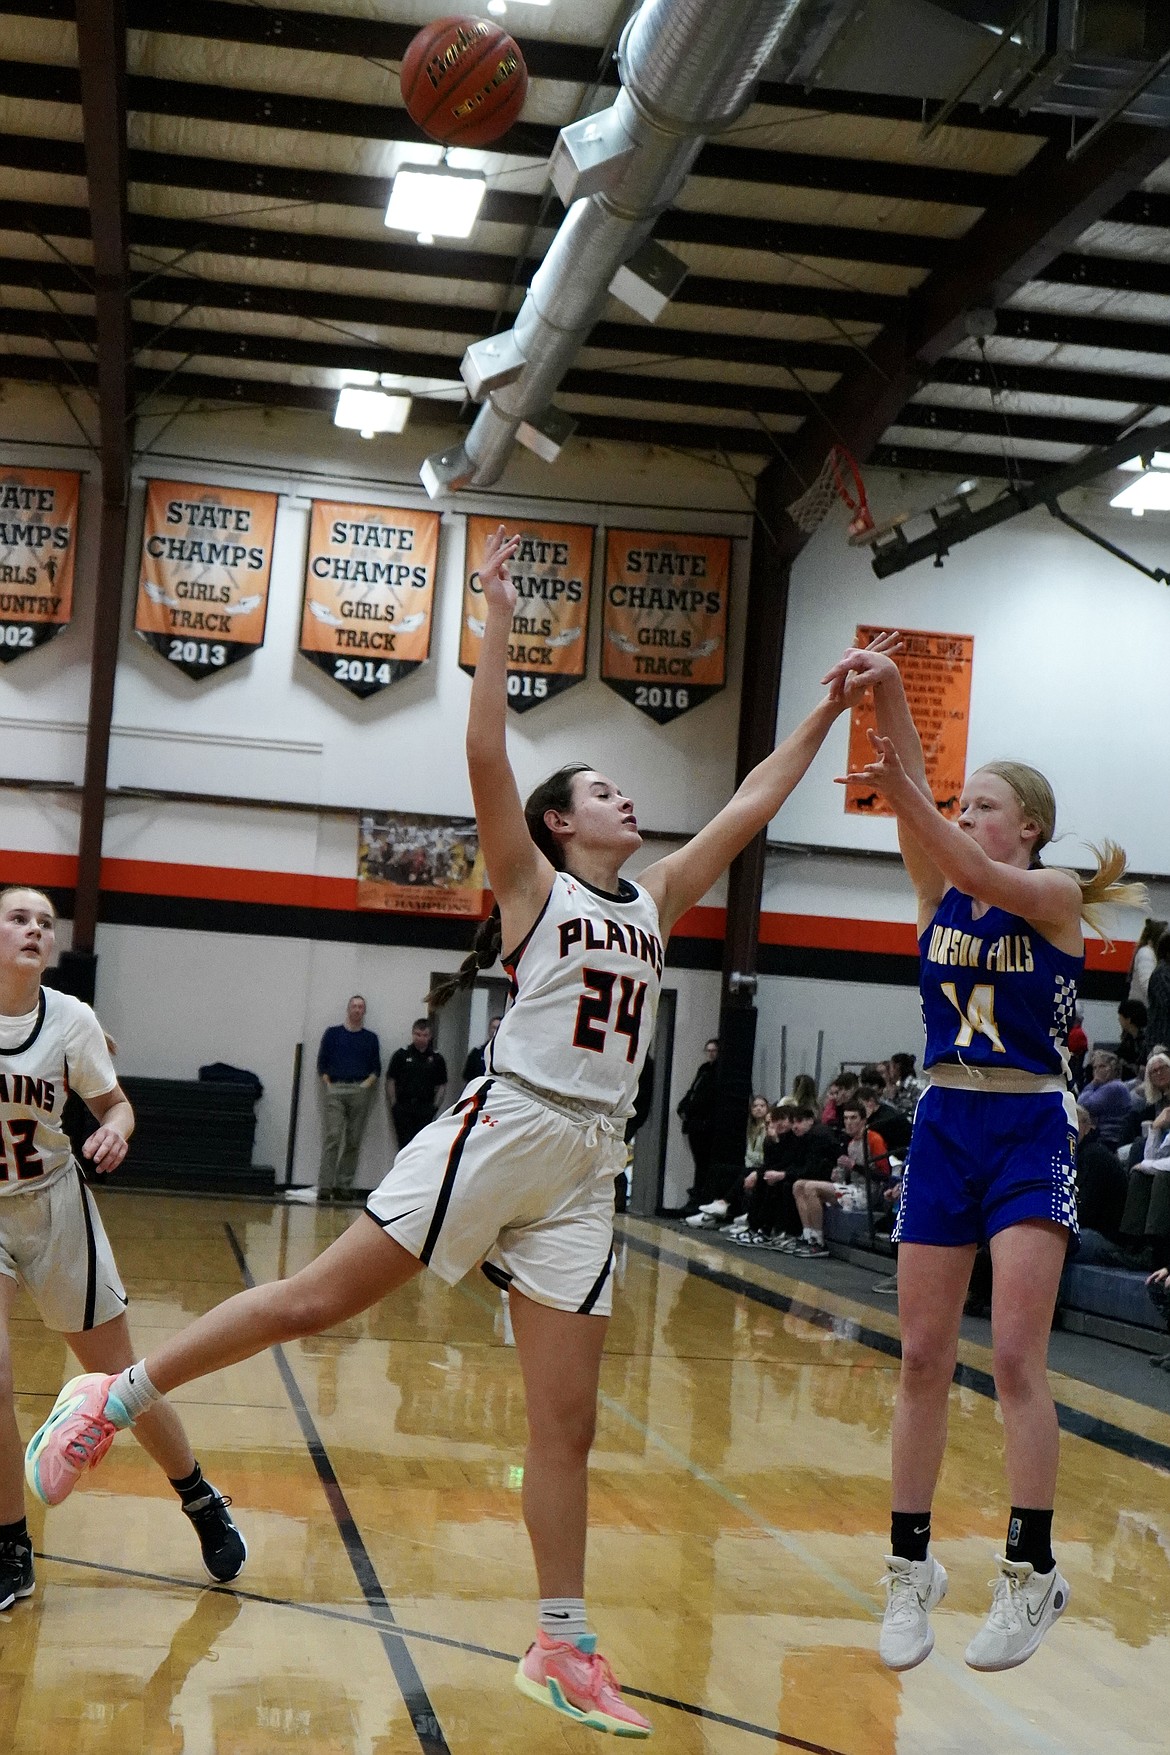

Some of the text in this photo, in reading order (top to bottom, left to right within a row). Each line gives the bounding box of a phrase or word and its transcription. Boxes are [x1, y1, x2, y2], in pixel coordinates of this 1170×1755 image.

[0, 487, 54, 512] ATE
[167, 501, 251, 532] STATE
[331, 521, 414, 551] STATE
[146, 534, 264, 570] CHAMPS
[626, 549, 707, 577] STATE
[312, 556, 427, 588] CHAMPS
[175, 581, 231, 604] GIRLS
[469, 570, 583, 602] CAMPS
[0, 594, 62, 615] UNTRY
[340, 600, 395, 622] GIRLS
[609, 584, 721, 615] CHAMPS
[168, 608, 232, 633] TRACK
[512, 615, 552, 636] IRLS
[335, 628, 397, 652] TRACK
[637, 628, 692, 648] GIRLS
[167, 639, 227, 666] 2013
[507, 644, 553, 664] RACK
[333, 659, 391, 684] 2014
[633, 655, 694, 677] TRACK
[507, 674, 549, 698] 015
[634, 686, 689, 709] 2016
[572, 967, 648, 1065] 24
[940, 981, 1007, 1054] 14
